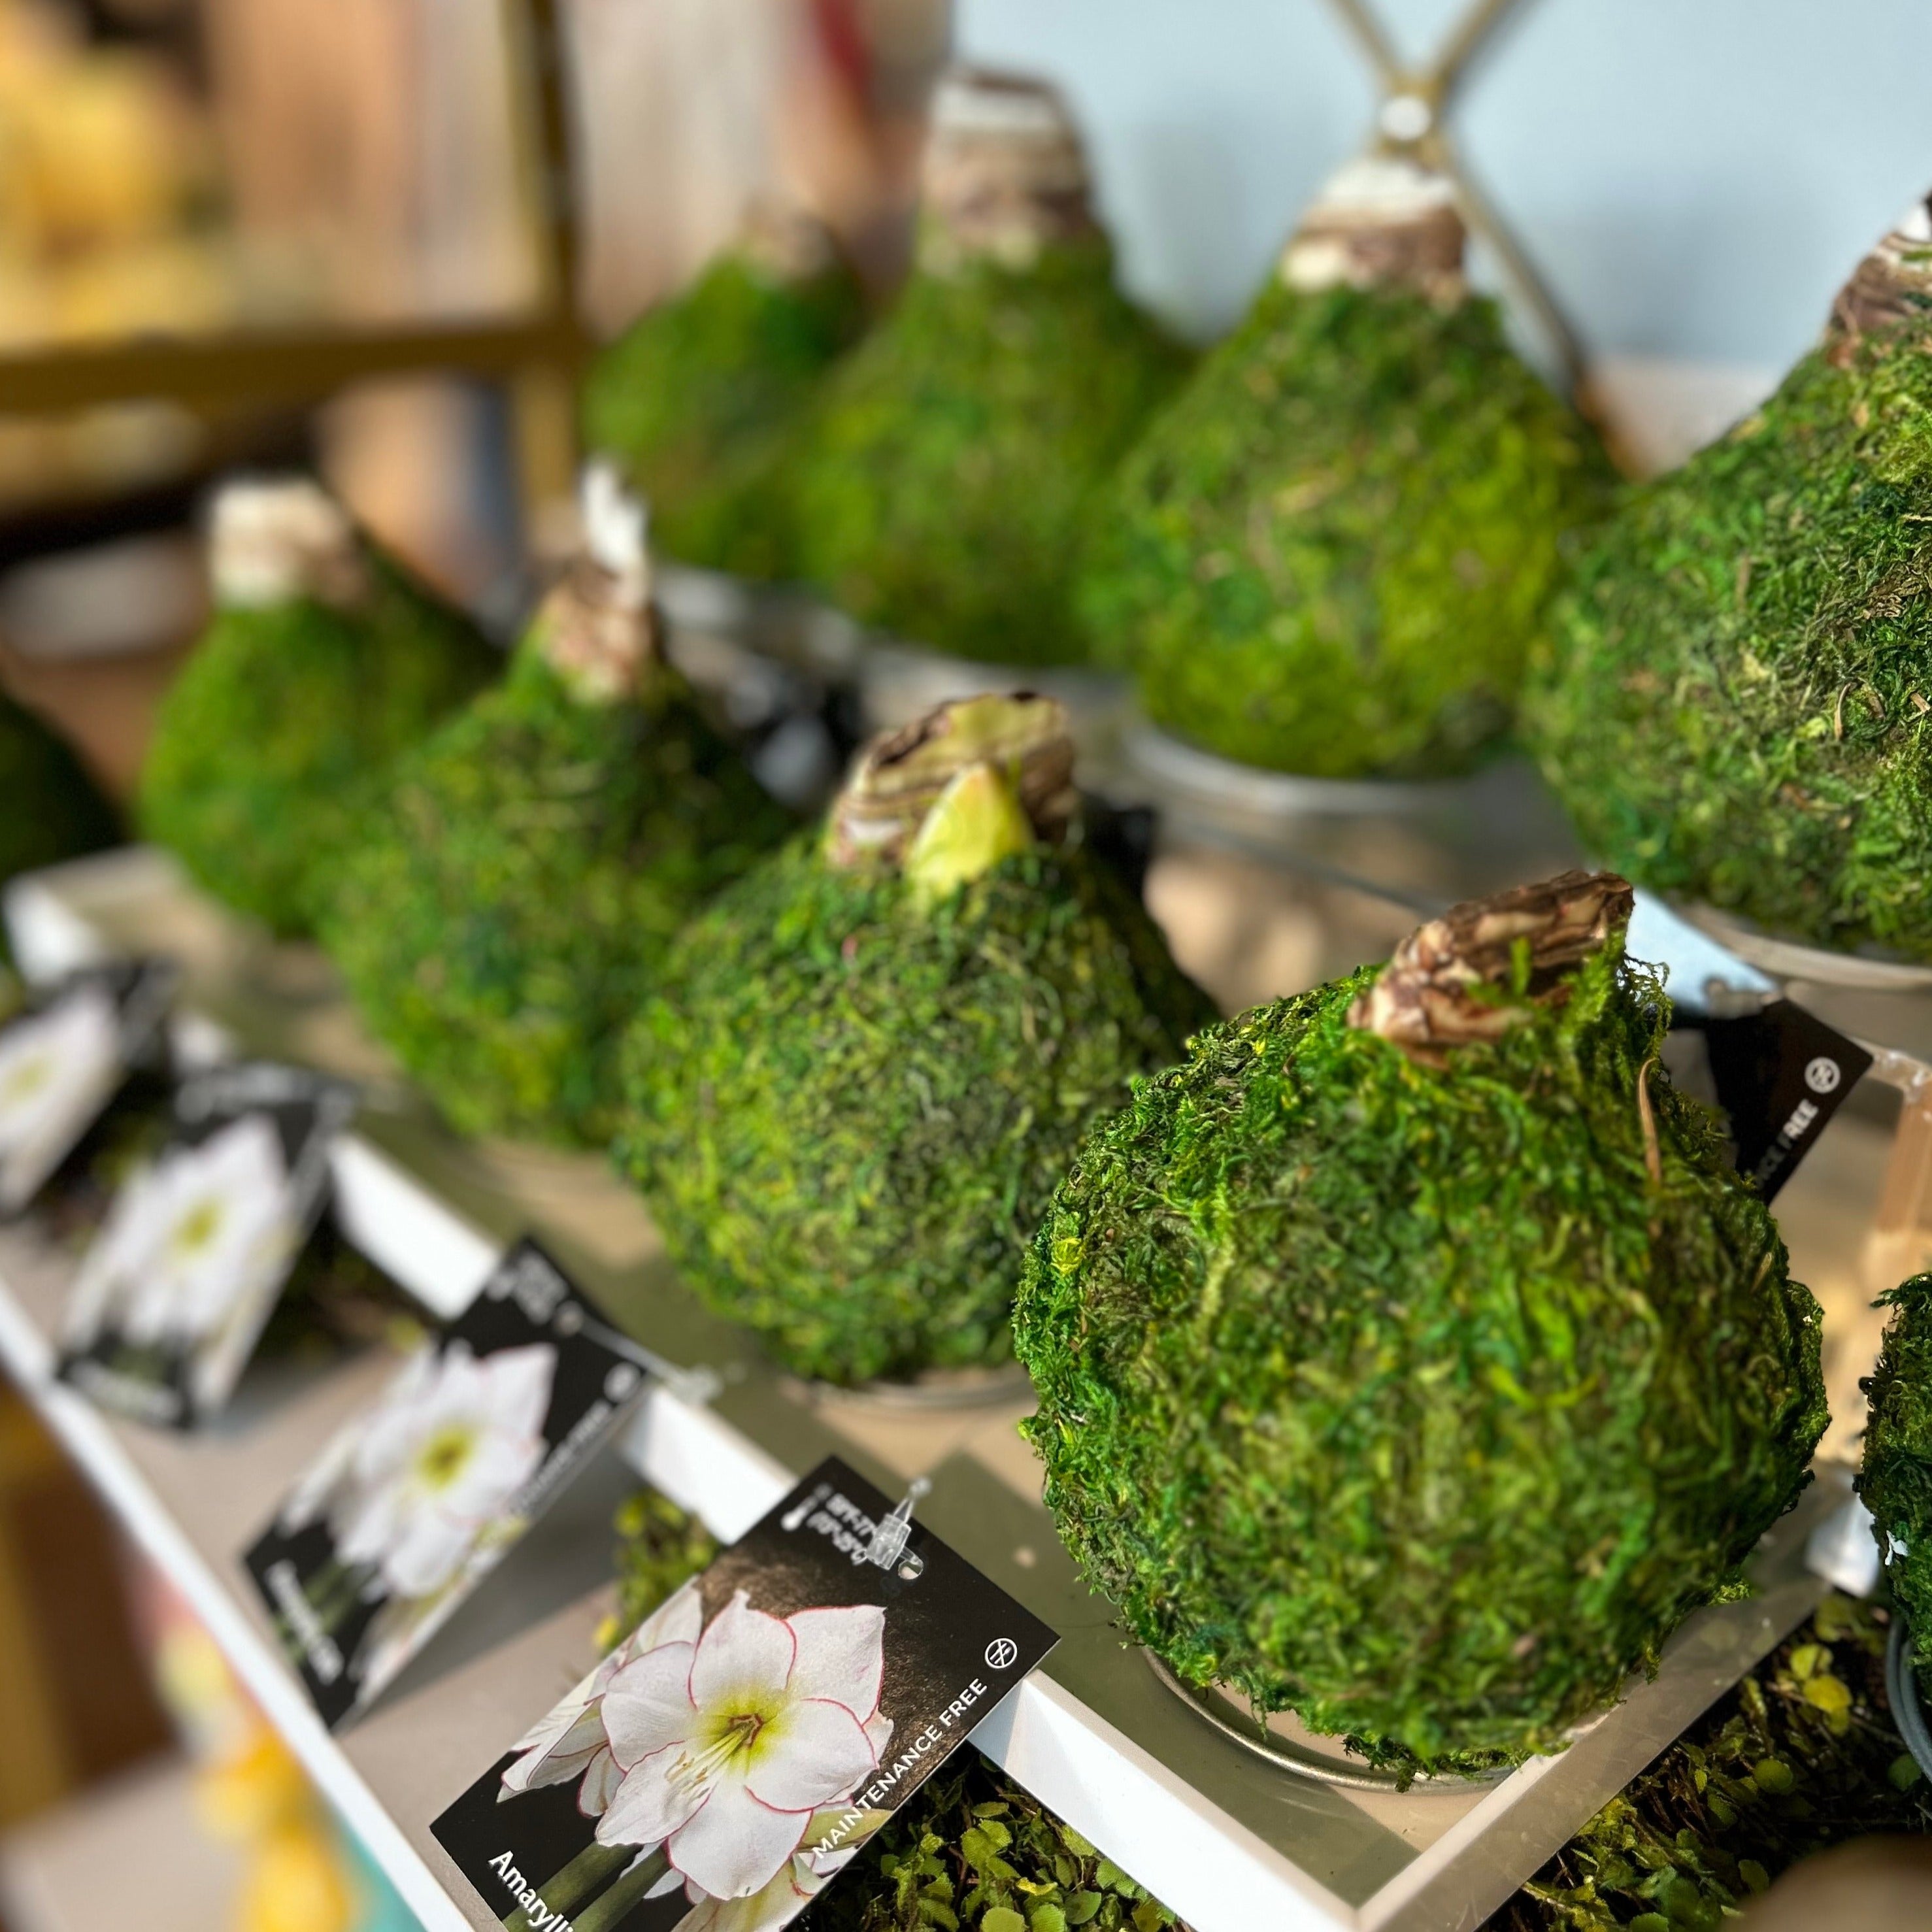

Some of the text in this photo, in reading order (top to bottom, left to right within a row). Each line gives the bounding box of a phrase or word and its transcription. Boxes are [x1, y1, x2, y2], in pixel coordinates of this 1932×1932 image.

[812, 1678, 988, 1859] MAINTENANCE FREE
[488, 1850, 574, 1932] Amaryll
